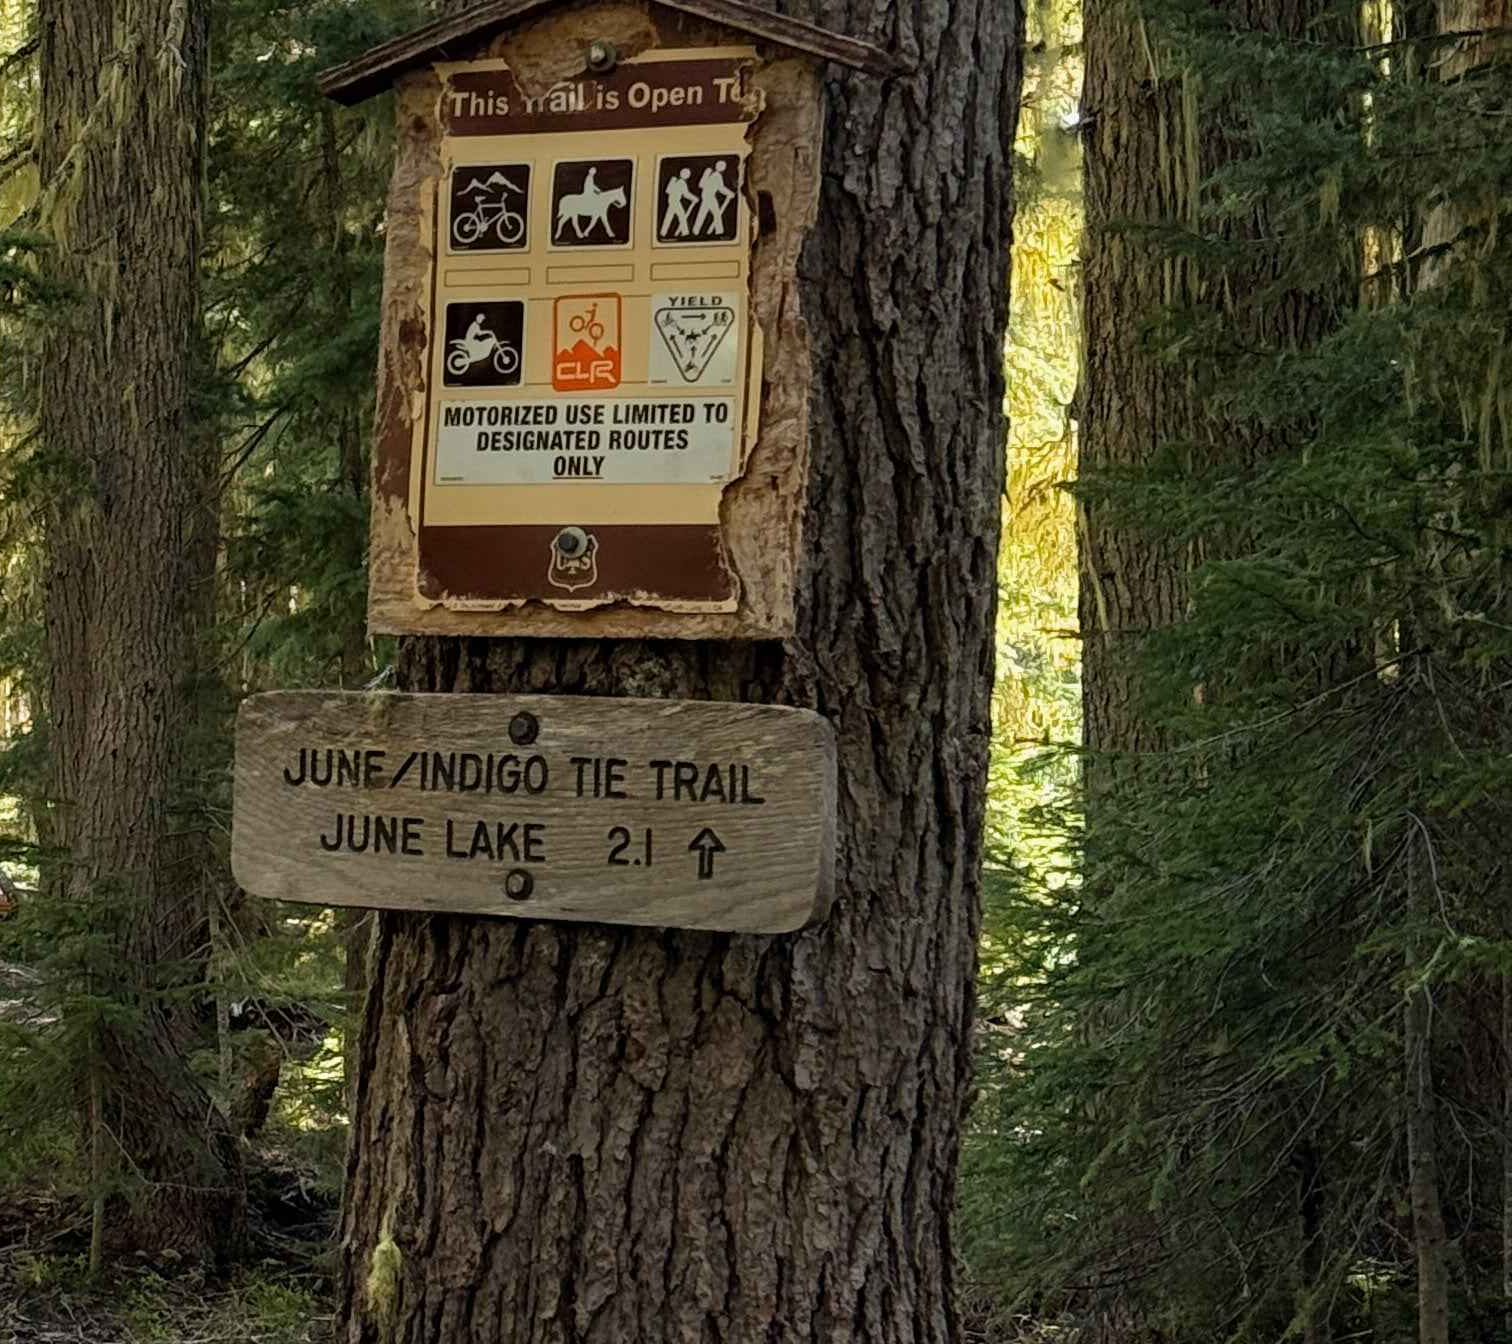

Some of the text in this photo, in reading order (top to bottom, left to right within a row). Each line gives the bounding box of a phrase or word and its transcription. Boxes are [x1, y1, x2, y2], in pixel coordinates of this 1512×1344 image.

[451, 90, 509, 118] This
[596, 84, 620, 110] is
[627, 82, 703, 113] Open
[668, 295, 723, 306] YIELD
[556, 360, 616, 384] CLR
[444, 402, 729, 427] MOTORIZED USE LIMITED TO
[476, 428, 689, 452] DESIGNATED ROUTES
[553, 455, 606, 477] ONLY
[283, 748, 766, 804] JUNE/INDIGO TIE TRAIL
[320, 813, 653, 867] JUNE LAKE 2.1
